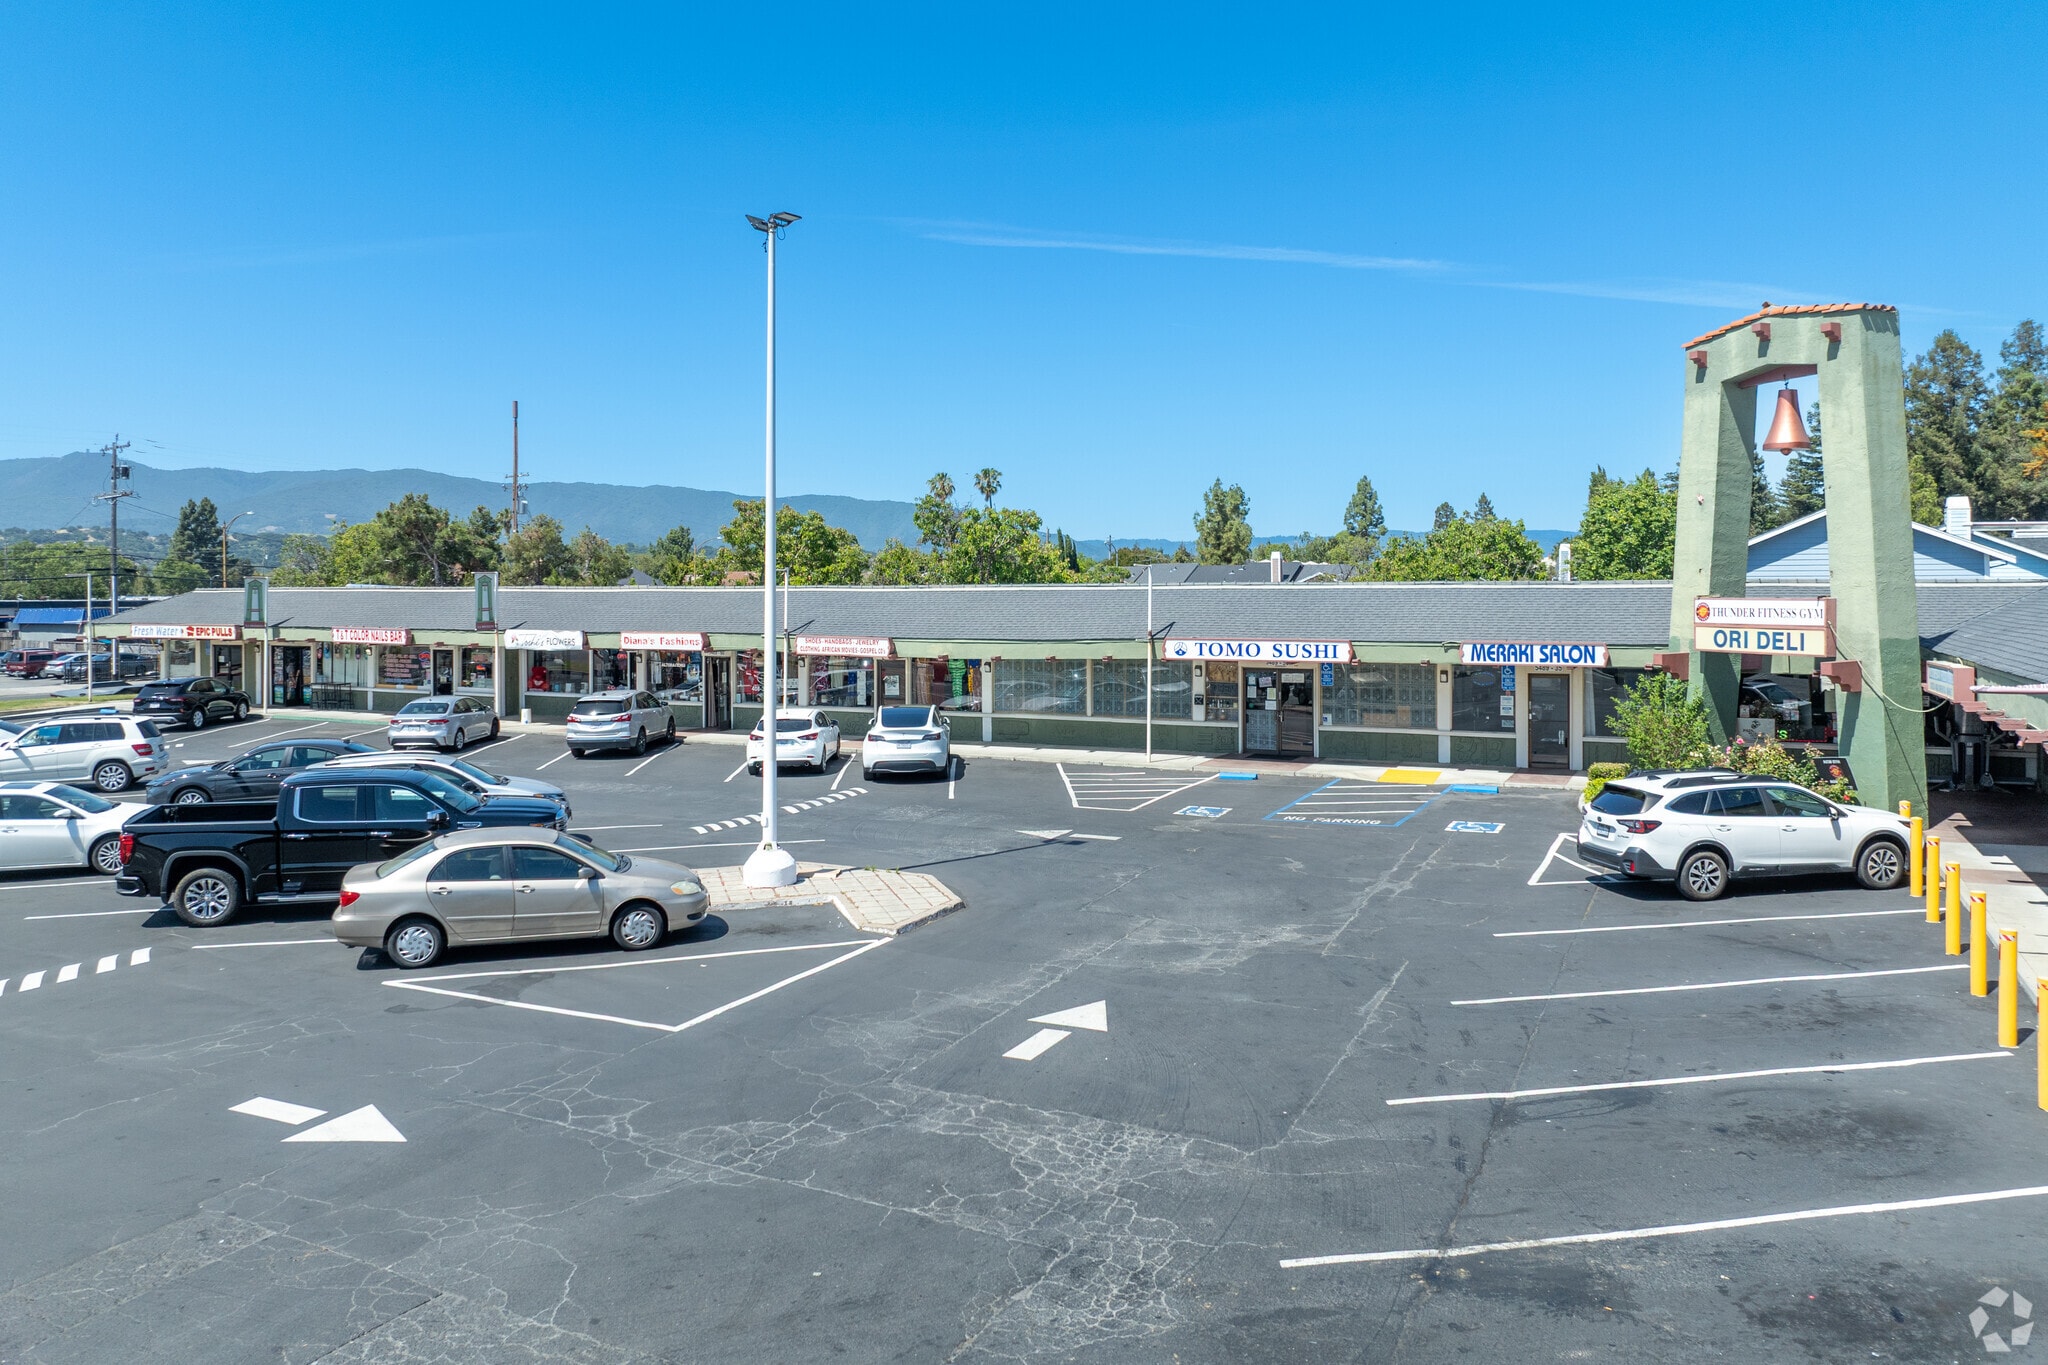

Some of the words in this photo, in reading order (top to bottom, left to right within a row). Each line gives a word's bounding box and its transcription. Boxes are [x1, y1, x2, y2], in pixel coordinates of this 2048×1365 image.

[1711, 607, 1756, 618] THUNDER
[1757, 608, 1797, 619] FITNESS
[1799, 608, 1824, 619] GYM
[133, 625, 154, 636] Fresh
[156, 626, 179, 636] Water
[195, 627, 211, 637] EPIC
[211, 627, 233, 637] PULLS
[350, 630, 370, 641] COLOR
[371, 631, 388, 642] NAILS
[390, 631, 403, 643] BAR
[623, 636, 655, 646] Diana's
[659, 636, 700, 646] Fashions
[805, 637, 822, 645] SHOES
[1713, 629, 1749, 649] ORI
[1757, 631, 1805, 652] DELI
[546, 637, 576, 647] FLOWERS
[800, 645, 821, 653] CLOTHING
[841, 646, 858, 654] MOVIES
[860, 647, 878, 655] GOSPEL
[1194, 642, 1261, 657] TOMO
[1272, 643, 1339, 659] SUSHI
[1470, 643, 1534, 663] MERAKI
[1539, 644, 1596, 664] SALON
[1312, 817, 1382, 825] PARKING
